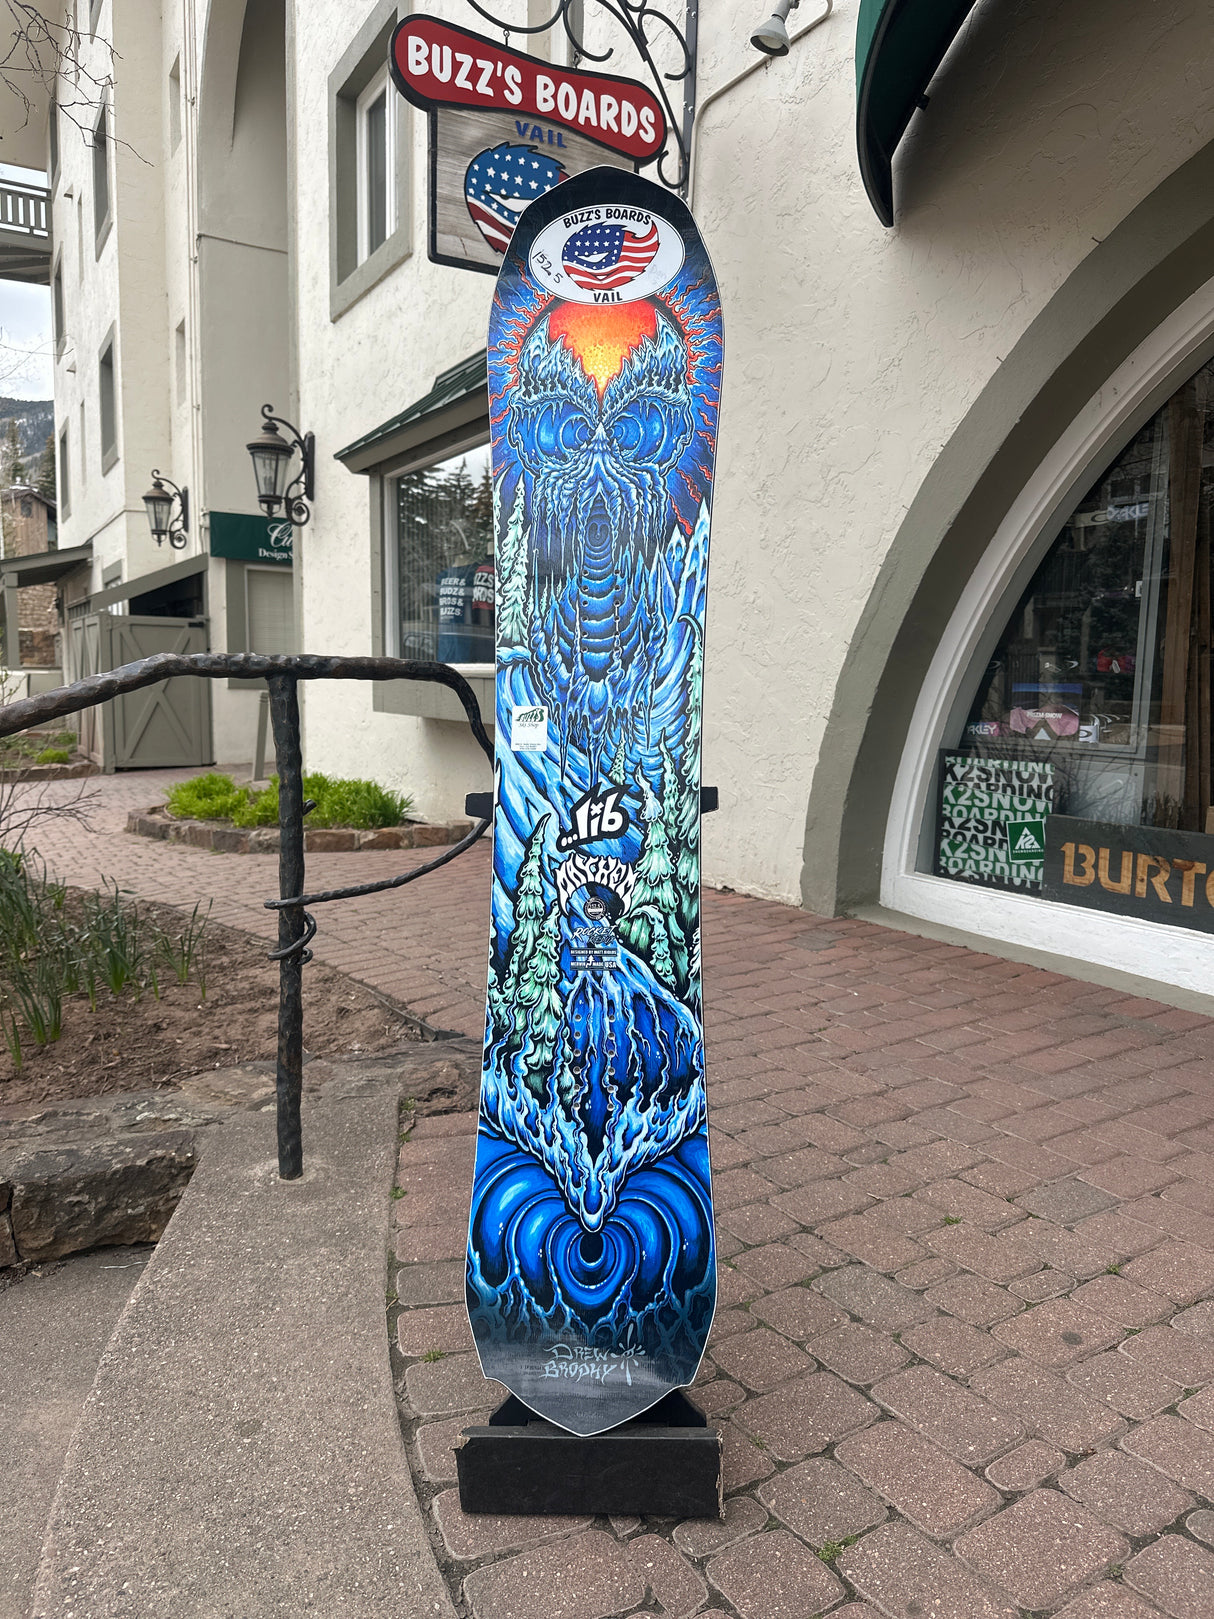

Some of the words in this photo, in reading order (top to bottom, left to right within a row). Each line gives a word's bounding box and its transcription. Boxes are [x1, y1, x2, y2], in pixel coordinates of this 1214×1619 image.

[407, 35, 523, 105] BUZZ'S
[536, 74, 656, 143] BOARDS
[515, 121, 567, 148] VAIL
[563, 209, 601, 229] BUZZ'S
[606, 208, 651, 225] BOARDS
[593, 291, 623, 303] VAIL
[258, 548, 288, 560] Design
[572, 925, 618, 942] ROCKET
[544, 1344, 610, 1361] DREW
[538, 1361, 618, 1385] BROPHY
